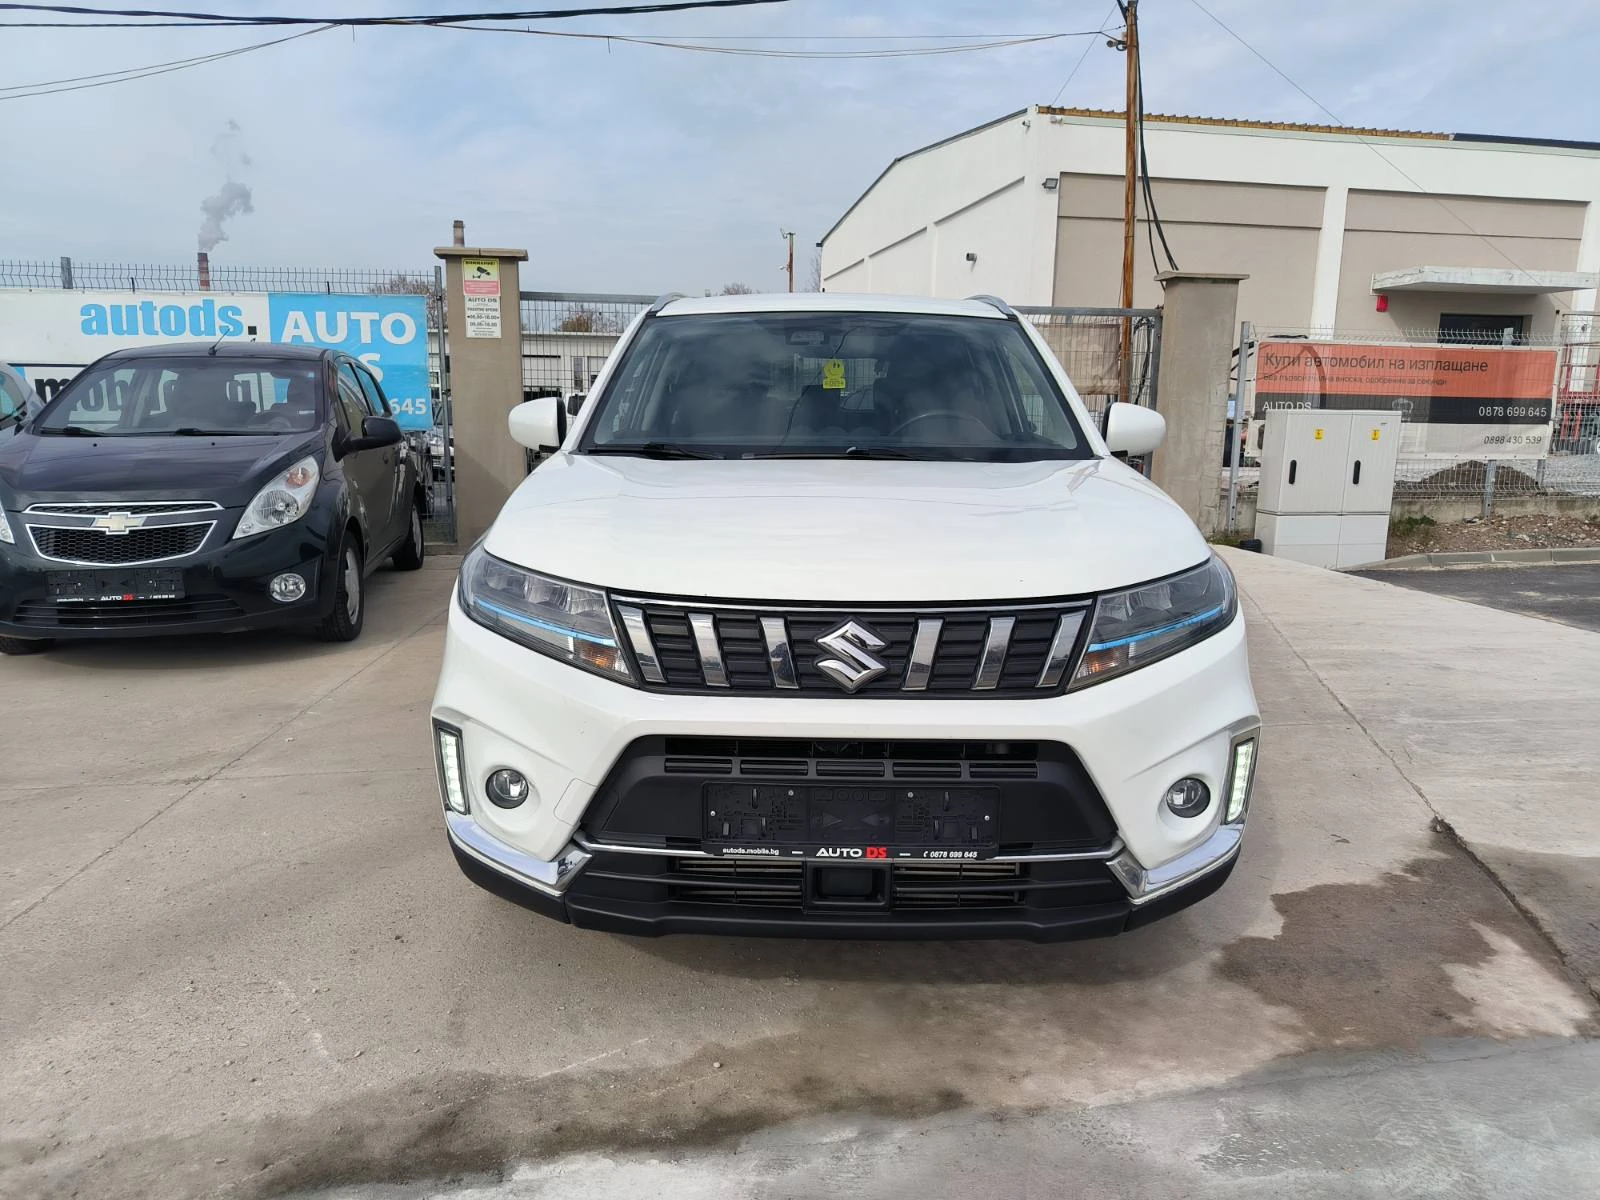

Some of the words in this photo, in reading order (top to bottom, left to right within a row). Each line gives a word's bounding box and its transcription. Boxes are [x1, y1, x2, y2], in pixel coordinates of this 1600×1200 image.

[281, 311, 417, 345] AUTO
[357, 352, 384, 385] S
[1265, 353, 1301, 368] Купи
[1304, 355, 1386, 370] автомобил
[1389, 359, 1405, 369] на
[1408, 359, 1489, 373] изплащане
[1263, 401, 1293, 411] AUTO
[1296, 402, 1312, 411] DS
[1478, 406, 1504, 417] 0878
[1506, 407, 1526, 417] 699
[1528, 407, 1547, 417] 645
[1483, 435, 1505, 445] 0898
[1506, 435, 1523, 444] 430
[1525, 435, 1542, 445] 539
[722, 847, 780, 856] autods.mobile.bg
[816, 847, 863, 858] AUTO
[865, 847, 887, 859] DS
